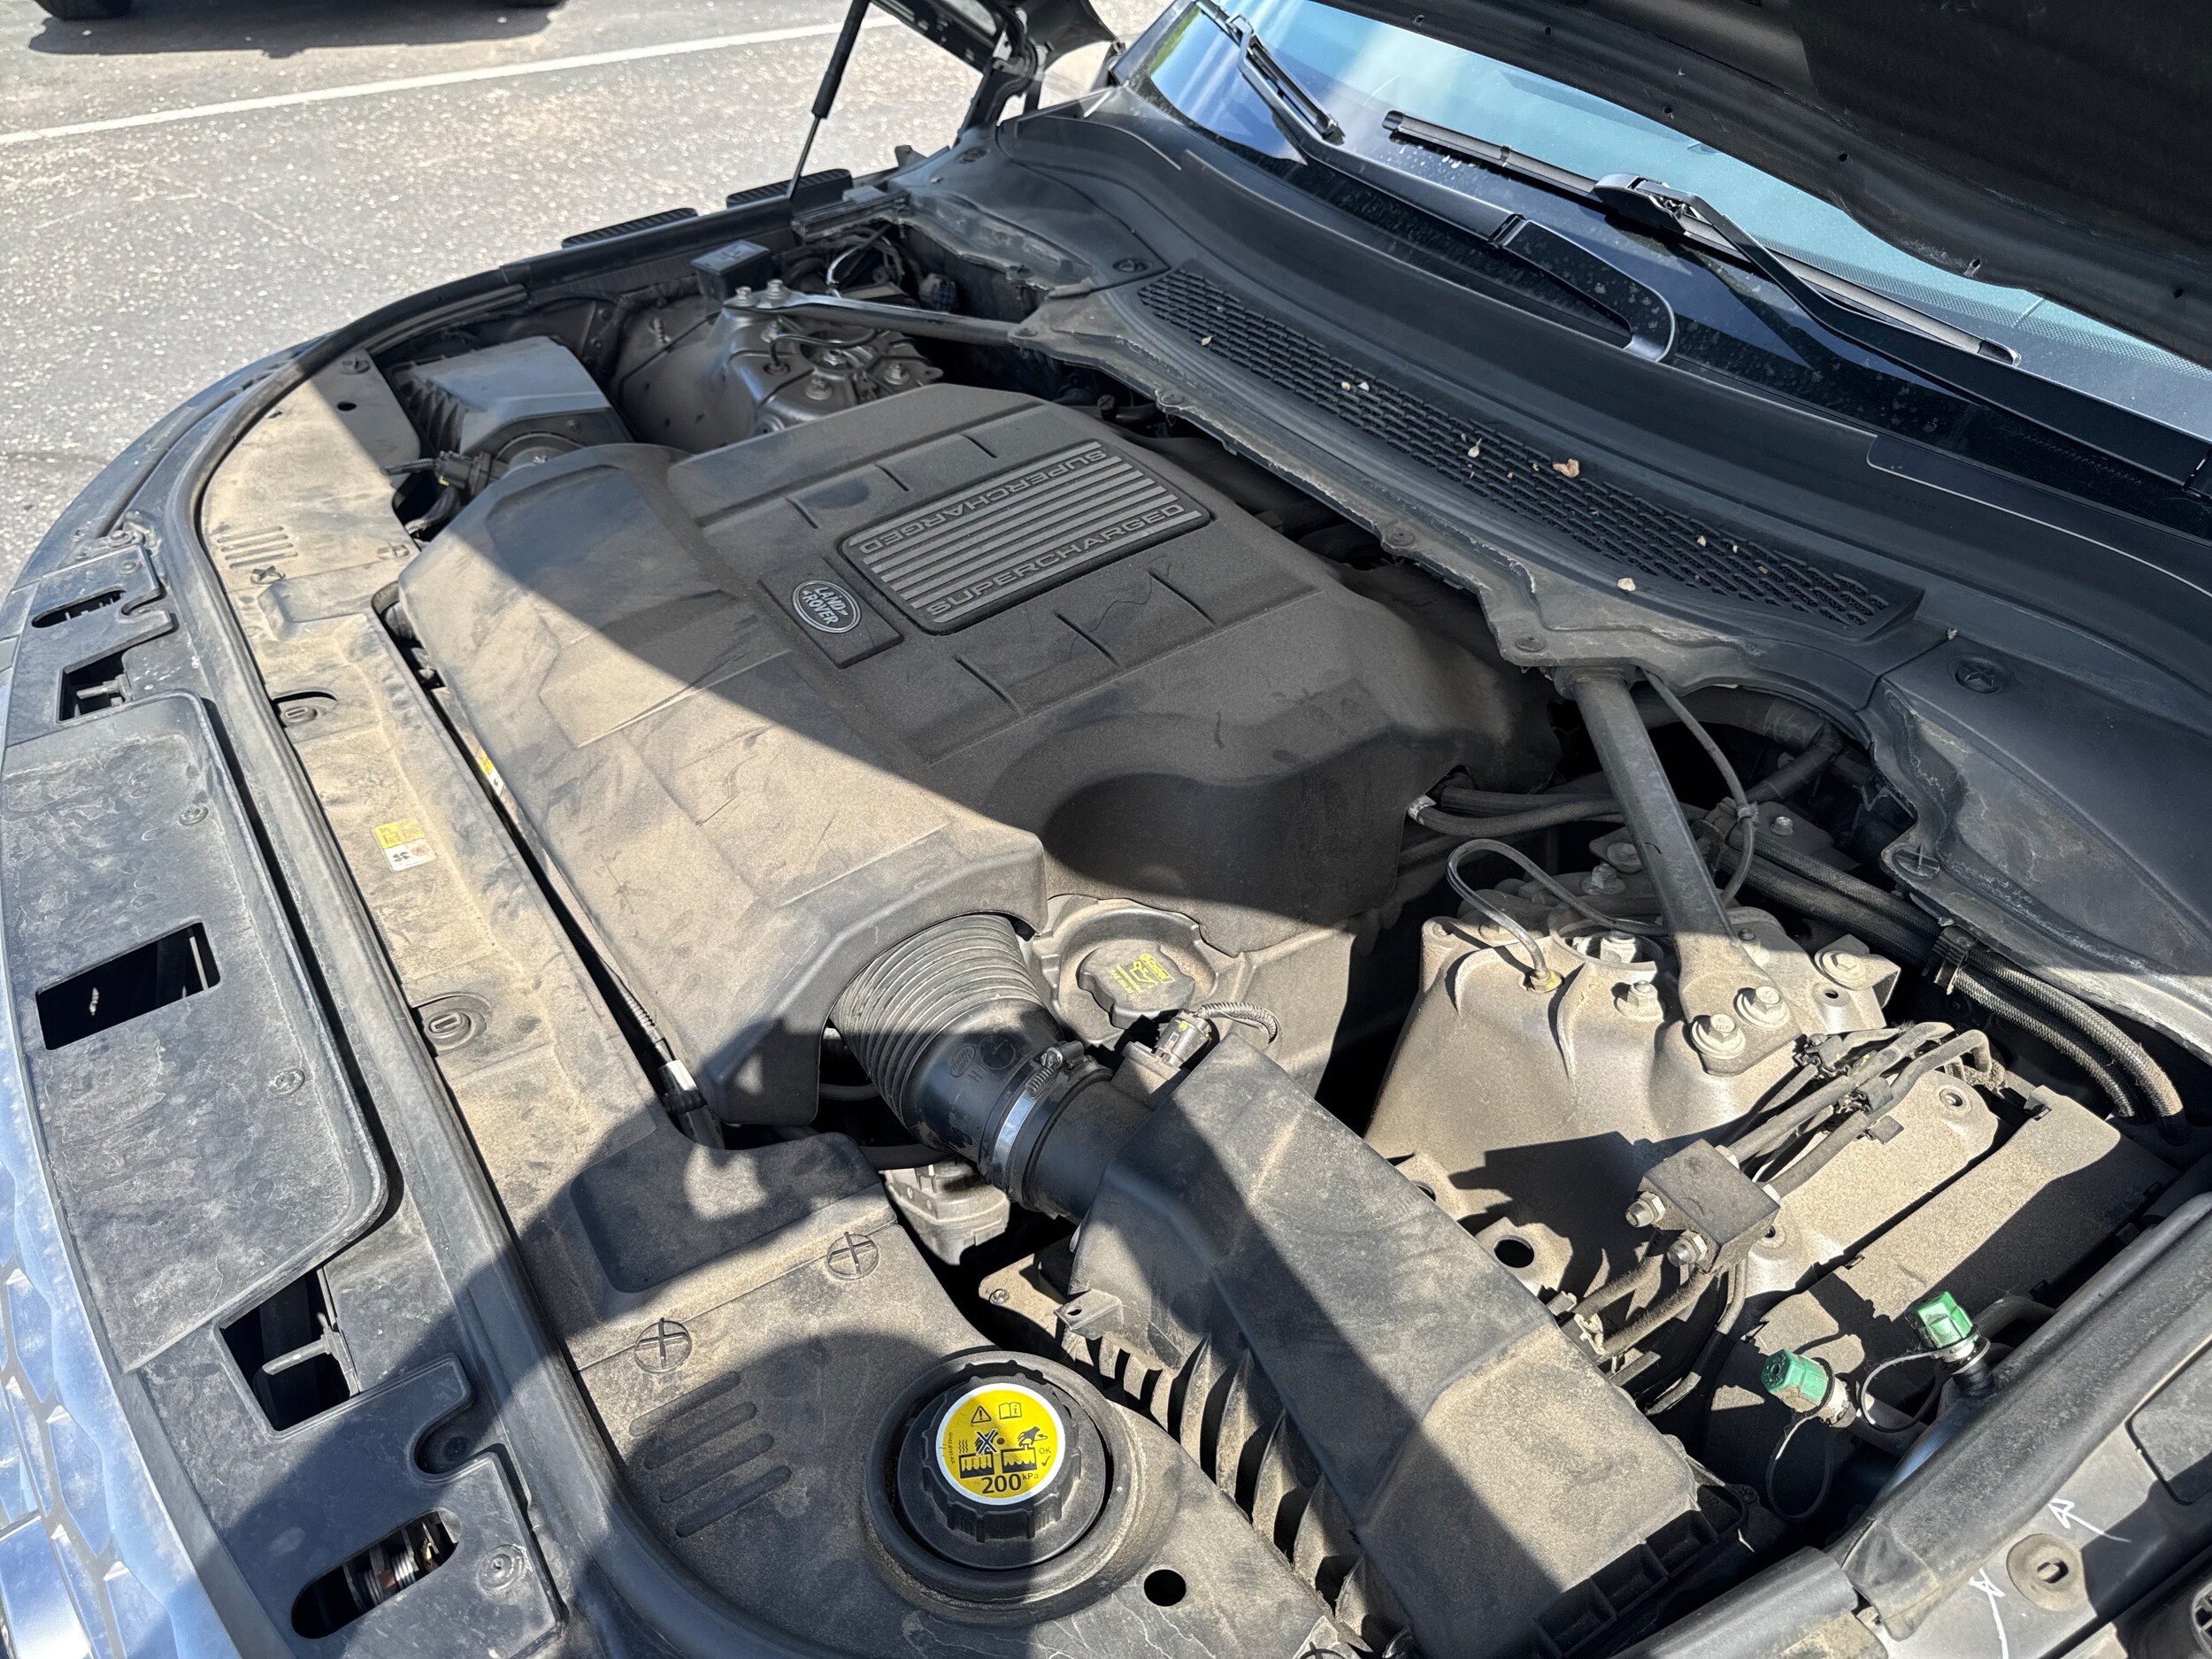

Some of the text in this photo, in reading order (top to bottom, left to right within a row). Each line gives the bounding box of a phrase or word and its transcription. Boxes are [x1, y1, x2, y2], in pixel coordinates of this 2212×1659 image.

[861, 450, 1108, 555] SUPERCHARGED
[927, 504, 1186, 616] SUPERCHARGED
[803, 593, 839, 625] ROVER
[814, 587, 847, 611] LAND
[981, 1474, 1021, 1494] 200
